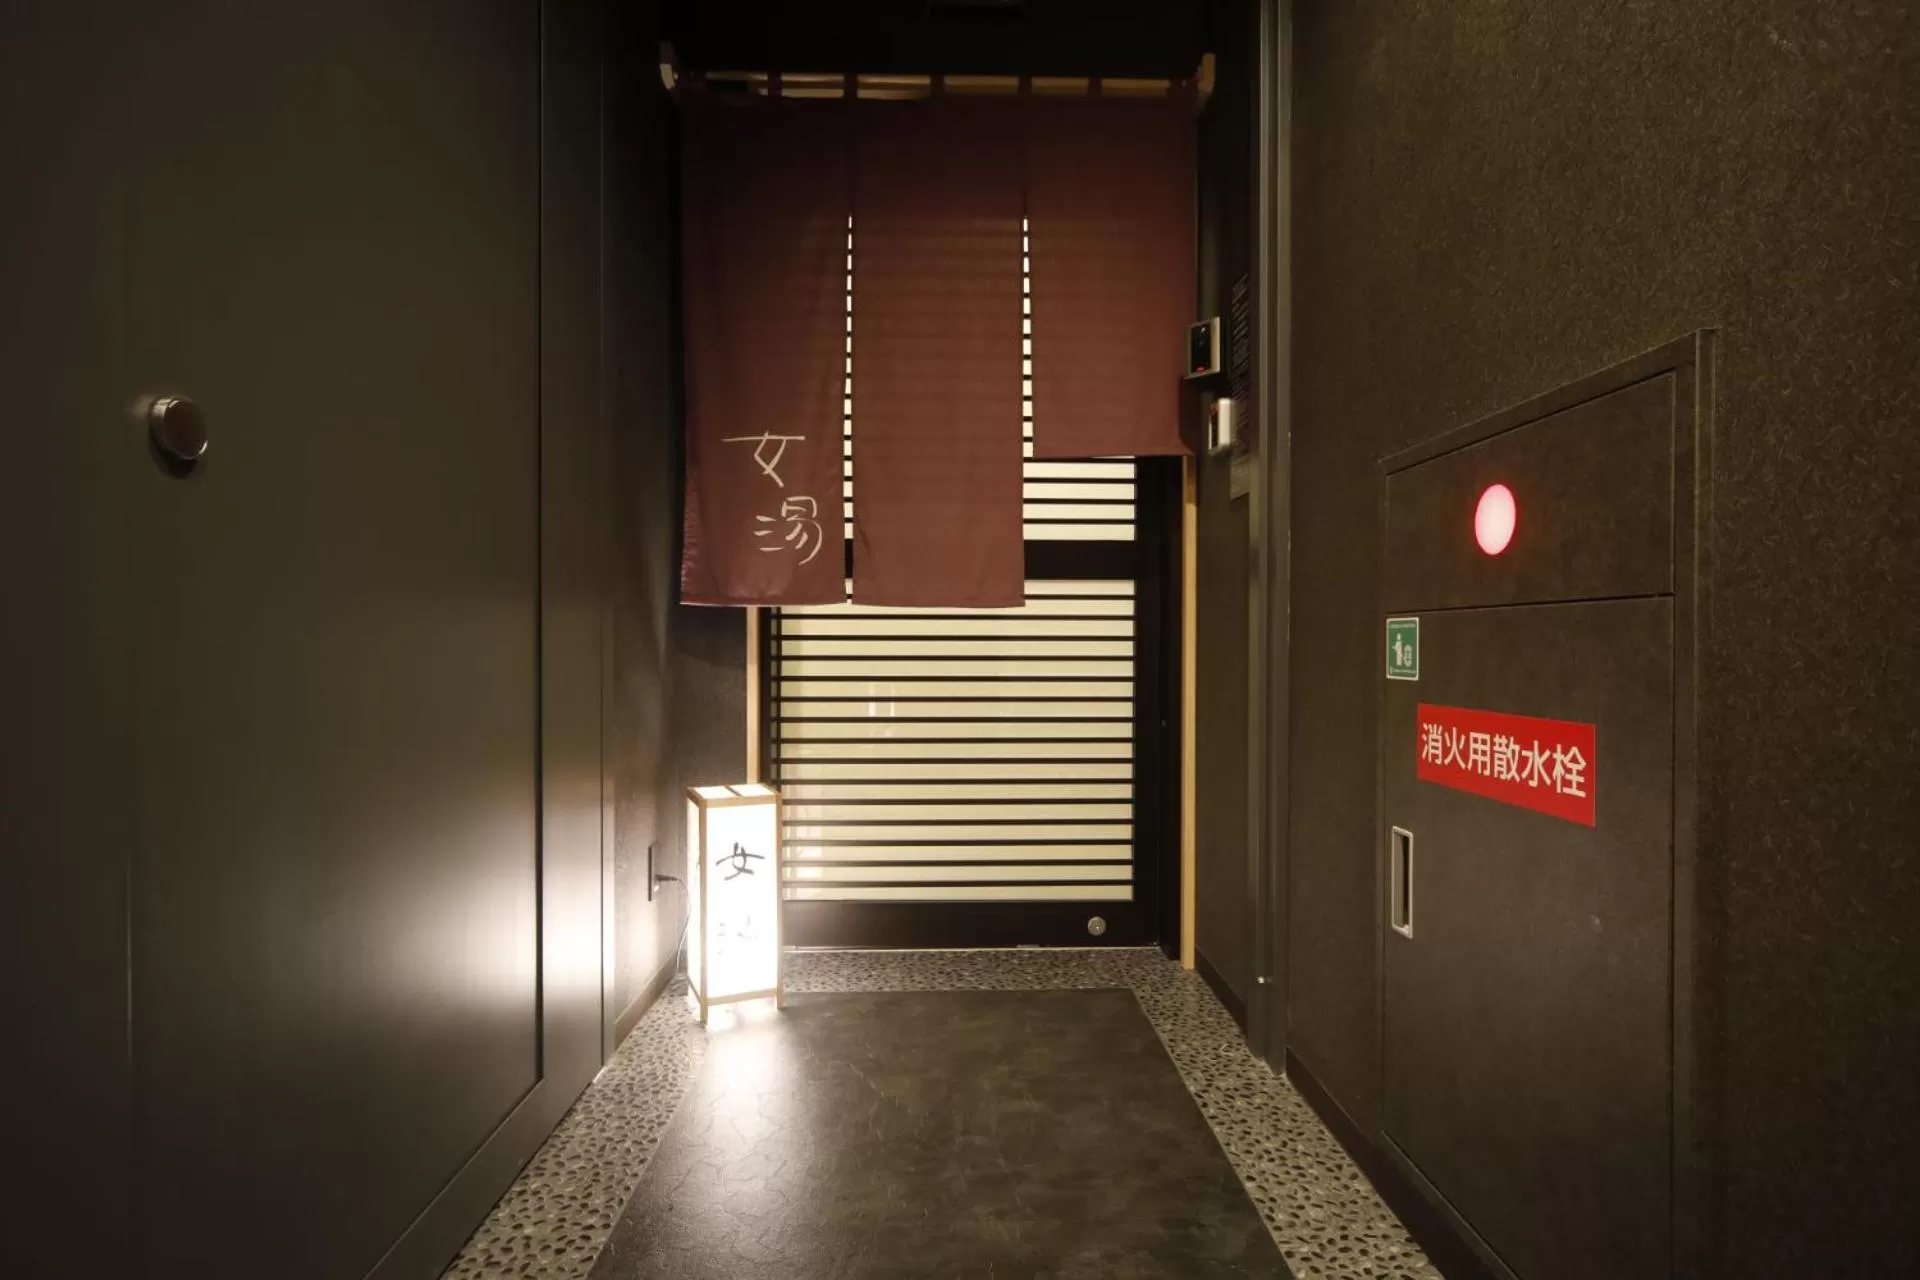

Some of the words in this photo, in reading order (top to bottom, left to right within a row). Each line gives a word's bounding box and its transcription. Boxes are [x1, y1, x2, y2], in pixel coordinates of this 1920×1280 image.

[721, 430, 822, 565] 女湯
[1421, 722, 1587, 798] 消火用散水栓
